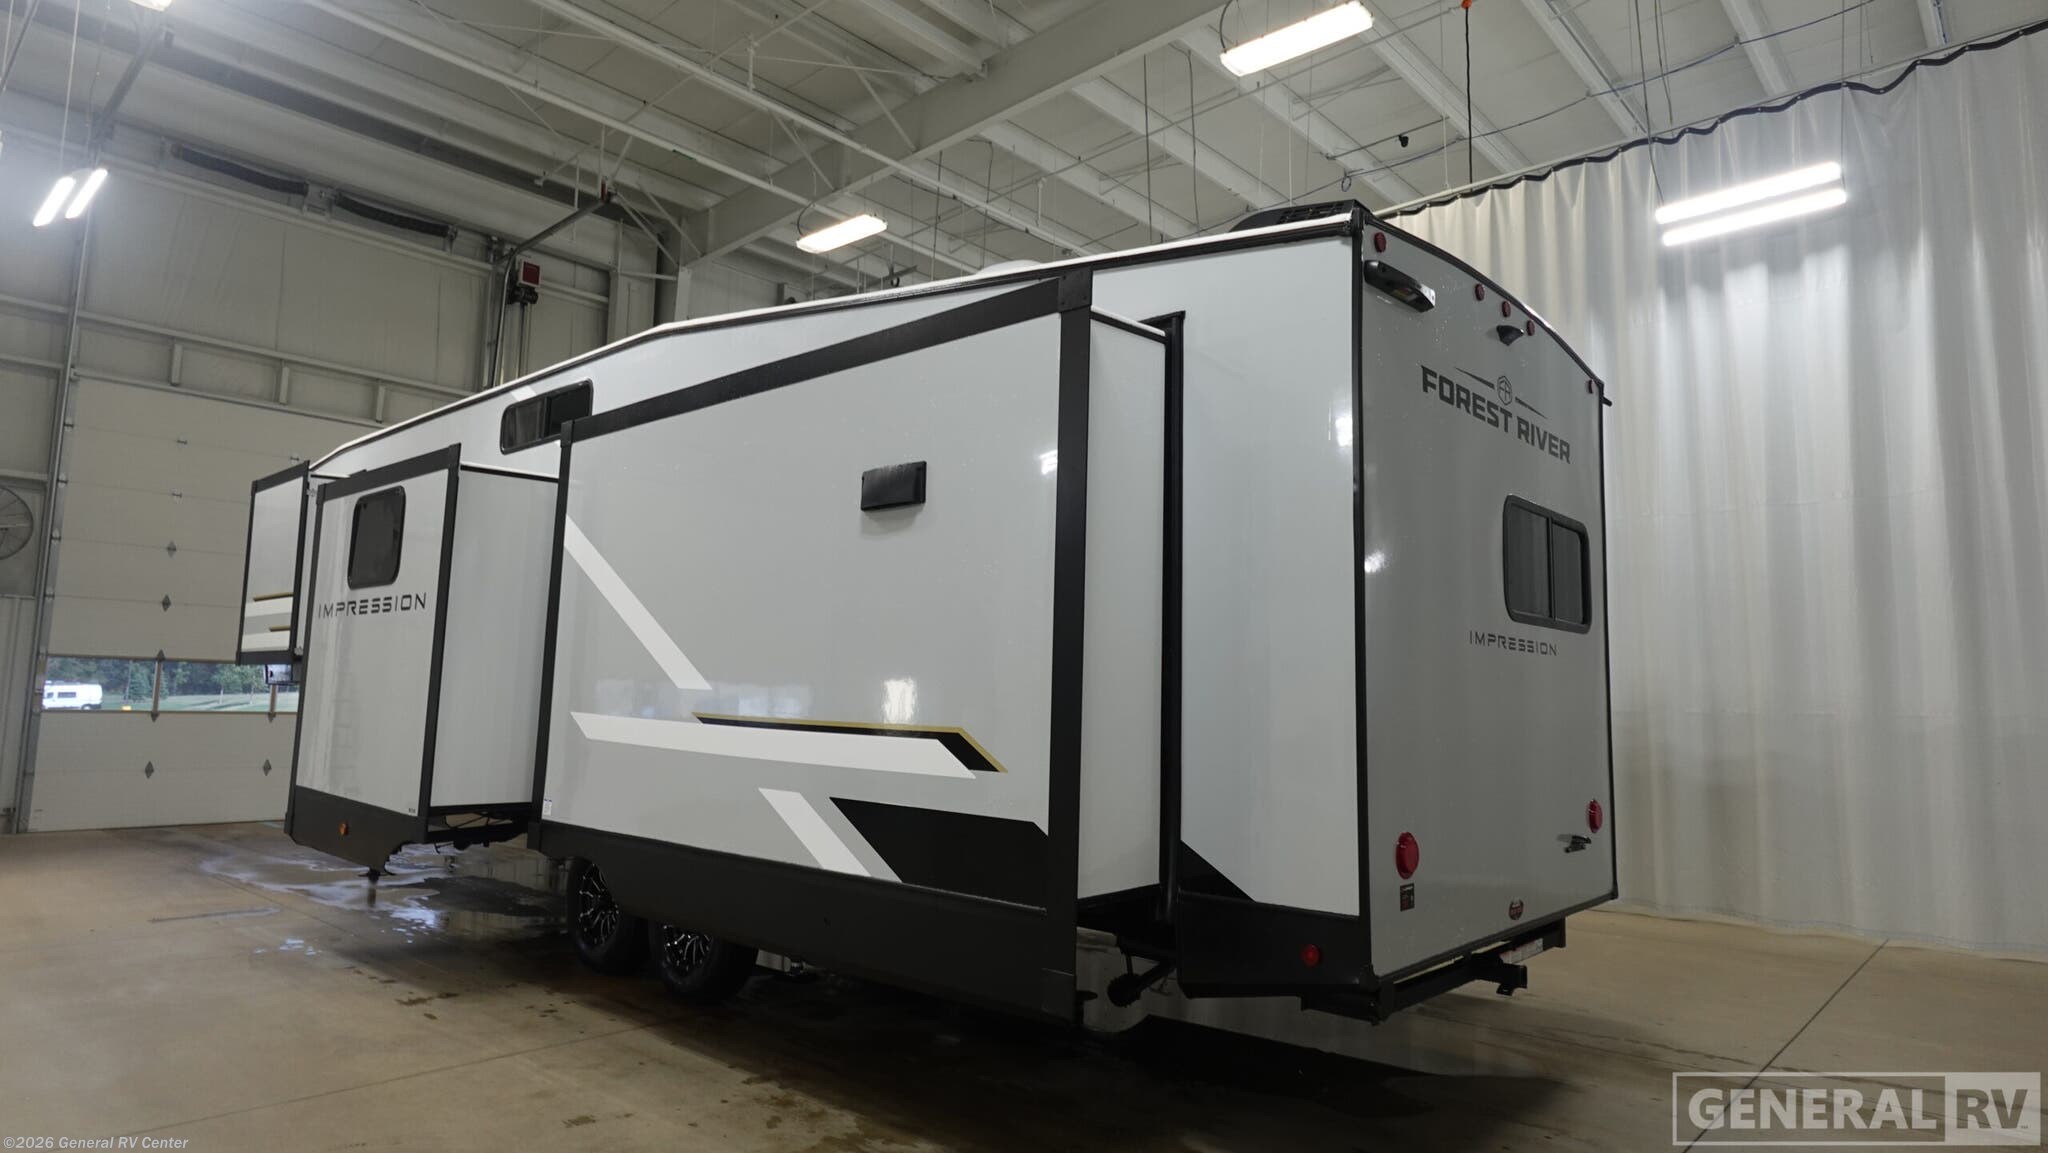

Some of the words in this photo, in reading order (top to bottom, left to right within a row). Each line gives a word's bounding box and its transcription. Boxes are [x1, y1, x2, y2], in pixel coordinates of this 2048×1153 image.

[1420, 364, 1513, 434] FOREST
[1516, 415, 1571, 465] RIVER
[318, 592, 427, 619] IMPRESSION
[1469, 630, 1558, 656] IMPRESSION
